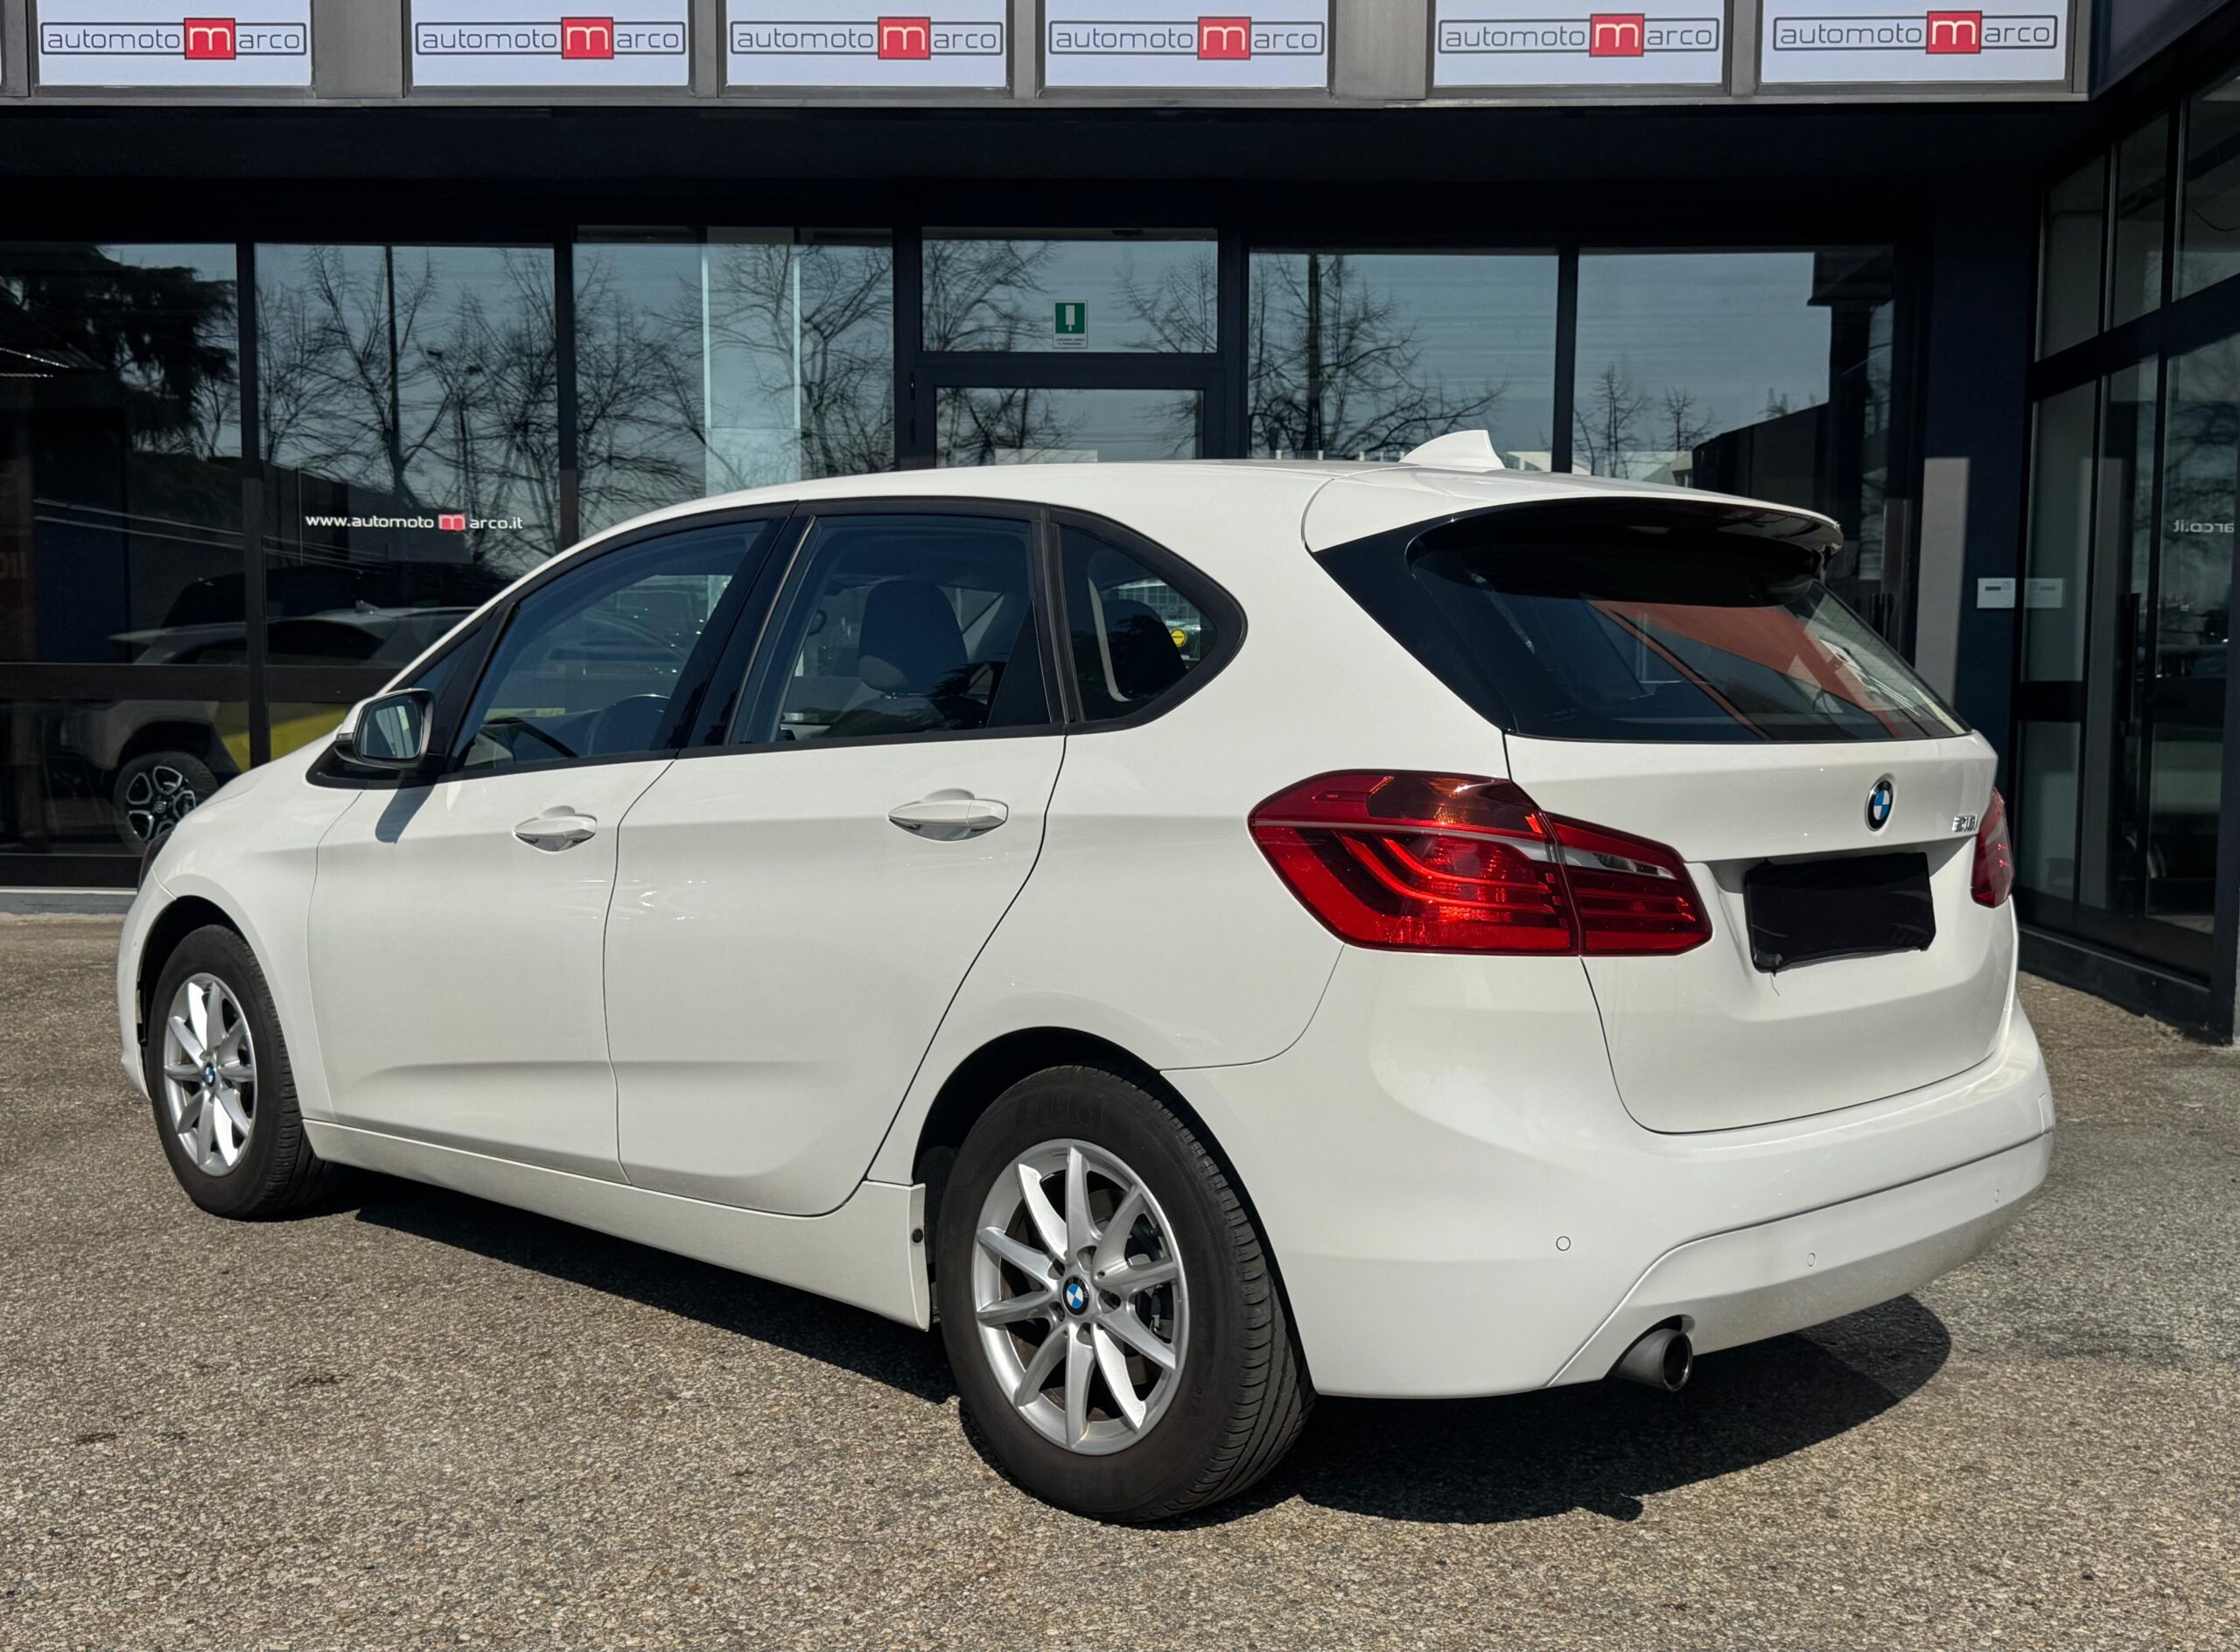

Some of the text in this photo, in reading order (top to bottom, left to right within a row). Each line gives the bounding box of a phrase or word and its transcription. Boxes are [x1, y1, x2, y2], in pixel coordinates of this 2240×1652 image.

[47, 28, 180, 49] automoto
[422, 28, 557, 49] automoto
[737, 27, 874, 49] automoto
[1055, 27, 1194, 49] automoto
[1445, 25, 1586, 47] automoto
[1780, 23, 1922, 44] automoto
